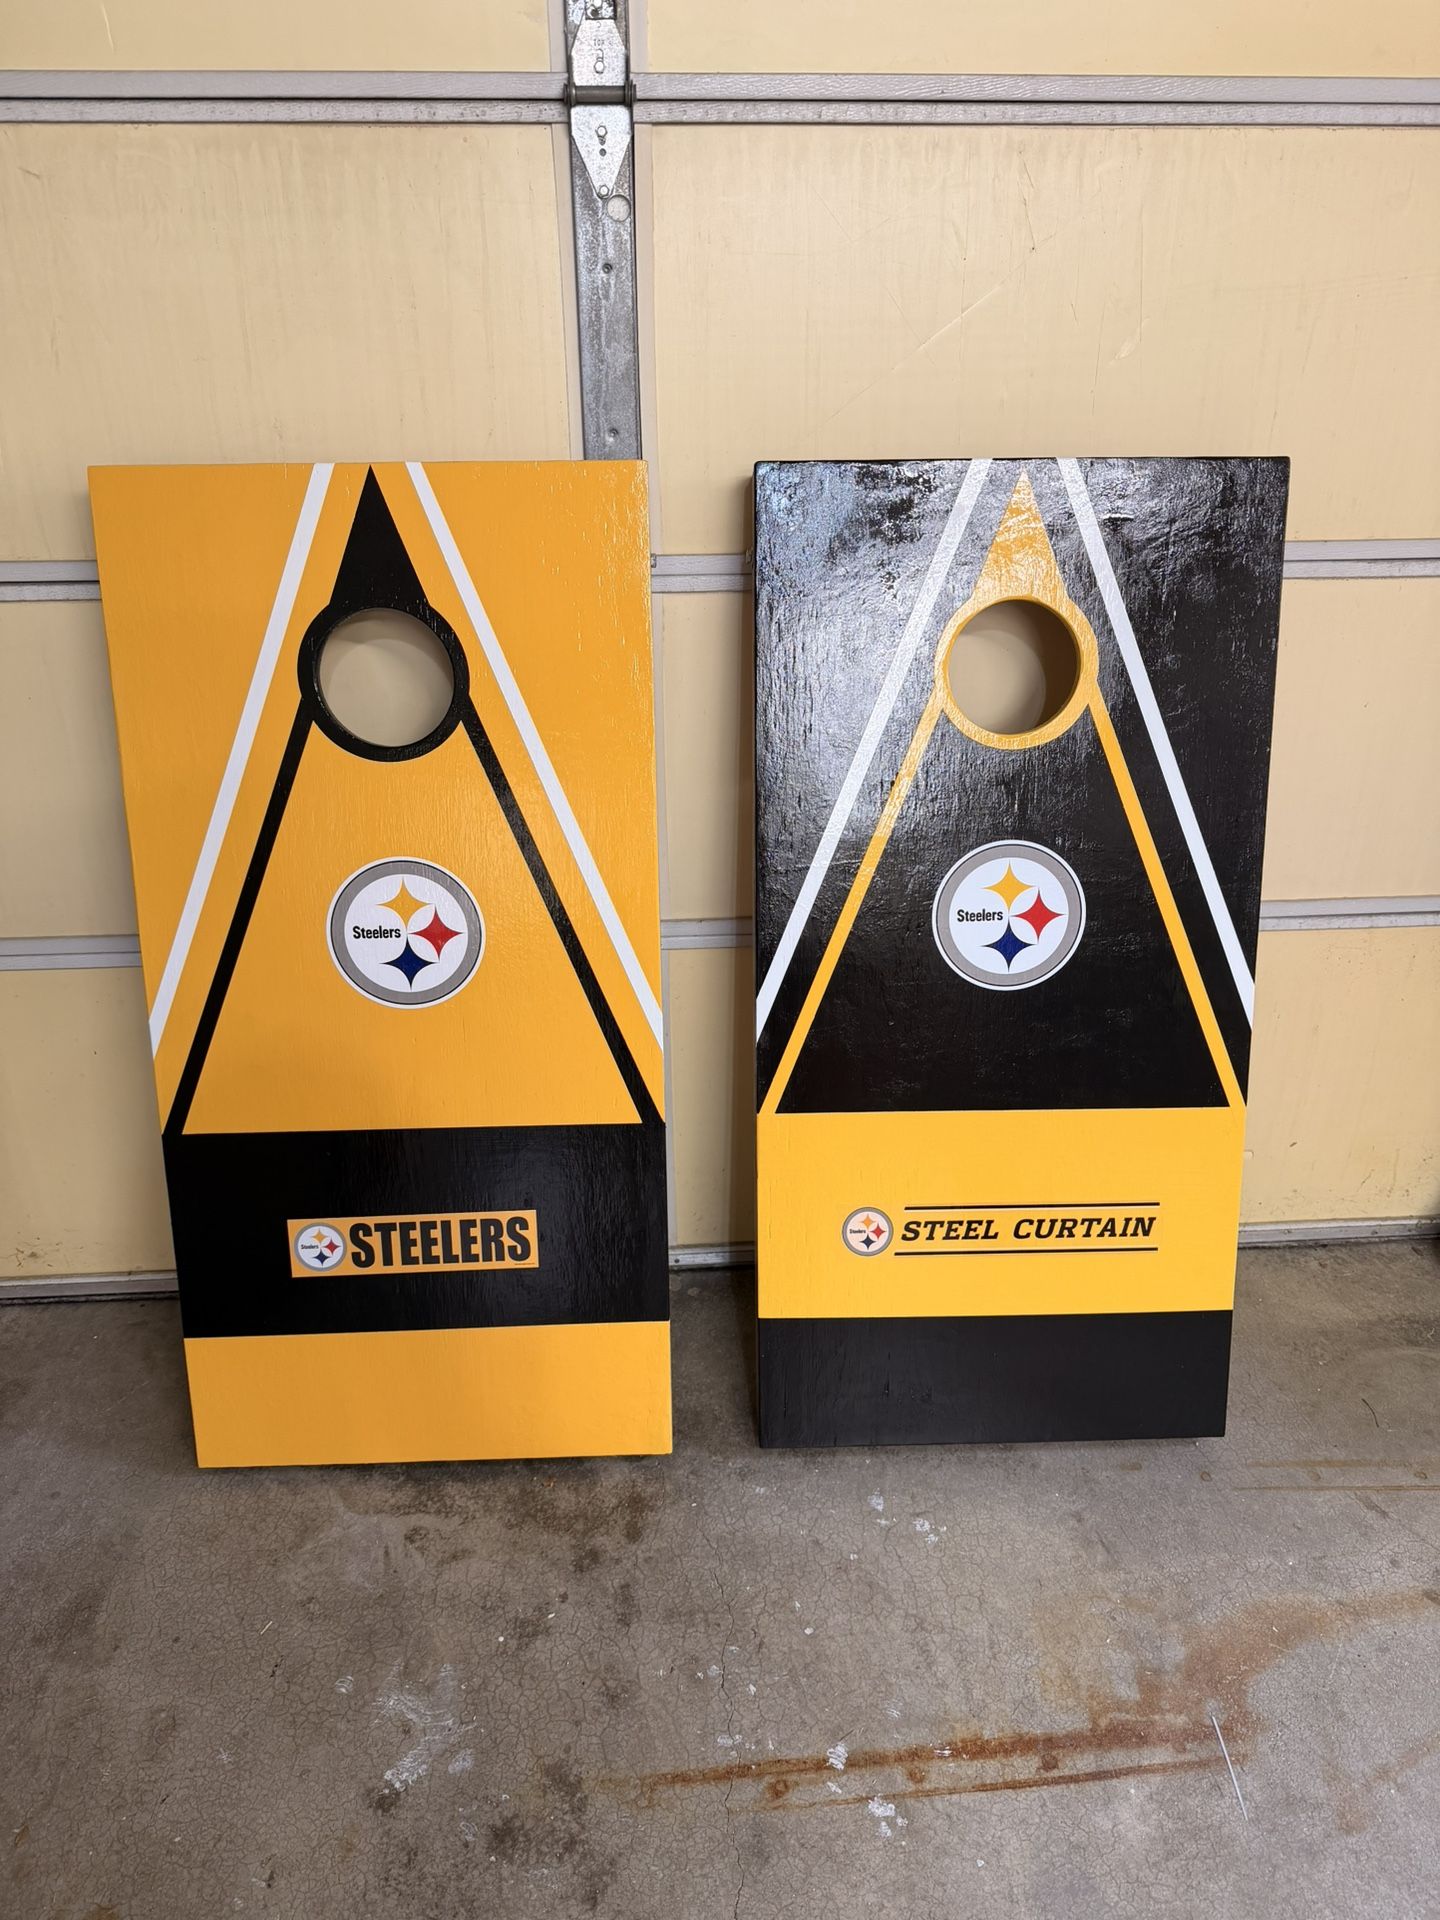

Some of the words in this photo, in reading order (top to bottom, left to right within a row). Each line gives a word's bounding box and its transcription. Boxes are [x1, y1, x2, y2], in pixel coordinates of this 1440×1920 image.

[957, 908, 1003, 922] Steelers
[352, 925, 401, 939] Steelers
[901, 1219, 999, 1241] STEEL
[1013, 1217, 1156, 1240] CURTAIN
[349, 1216, 532, 1269] STEELERS
